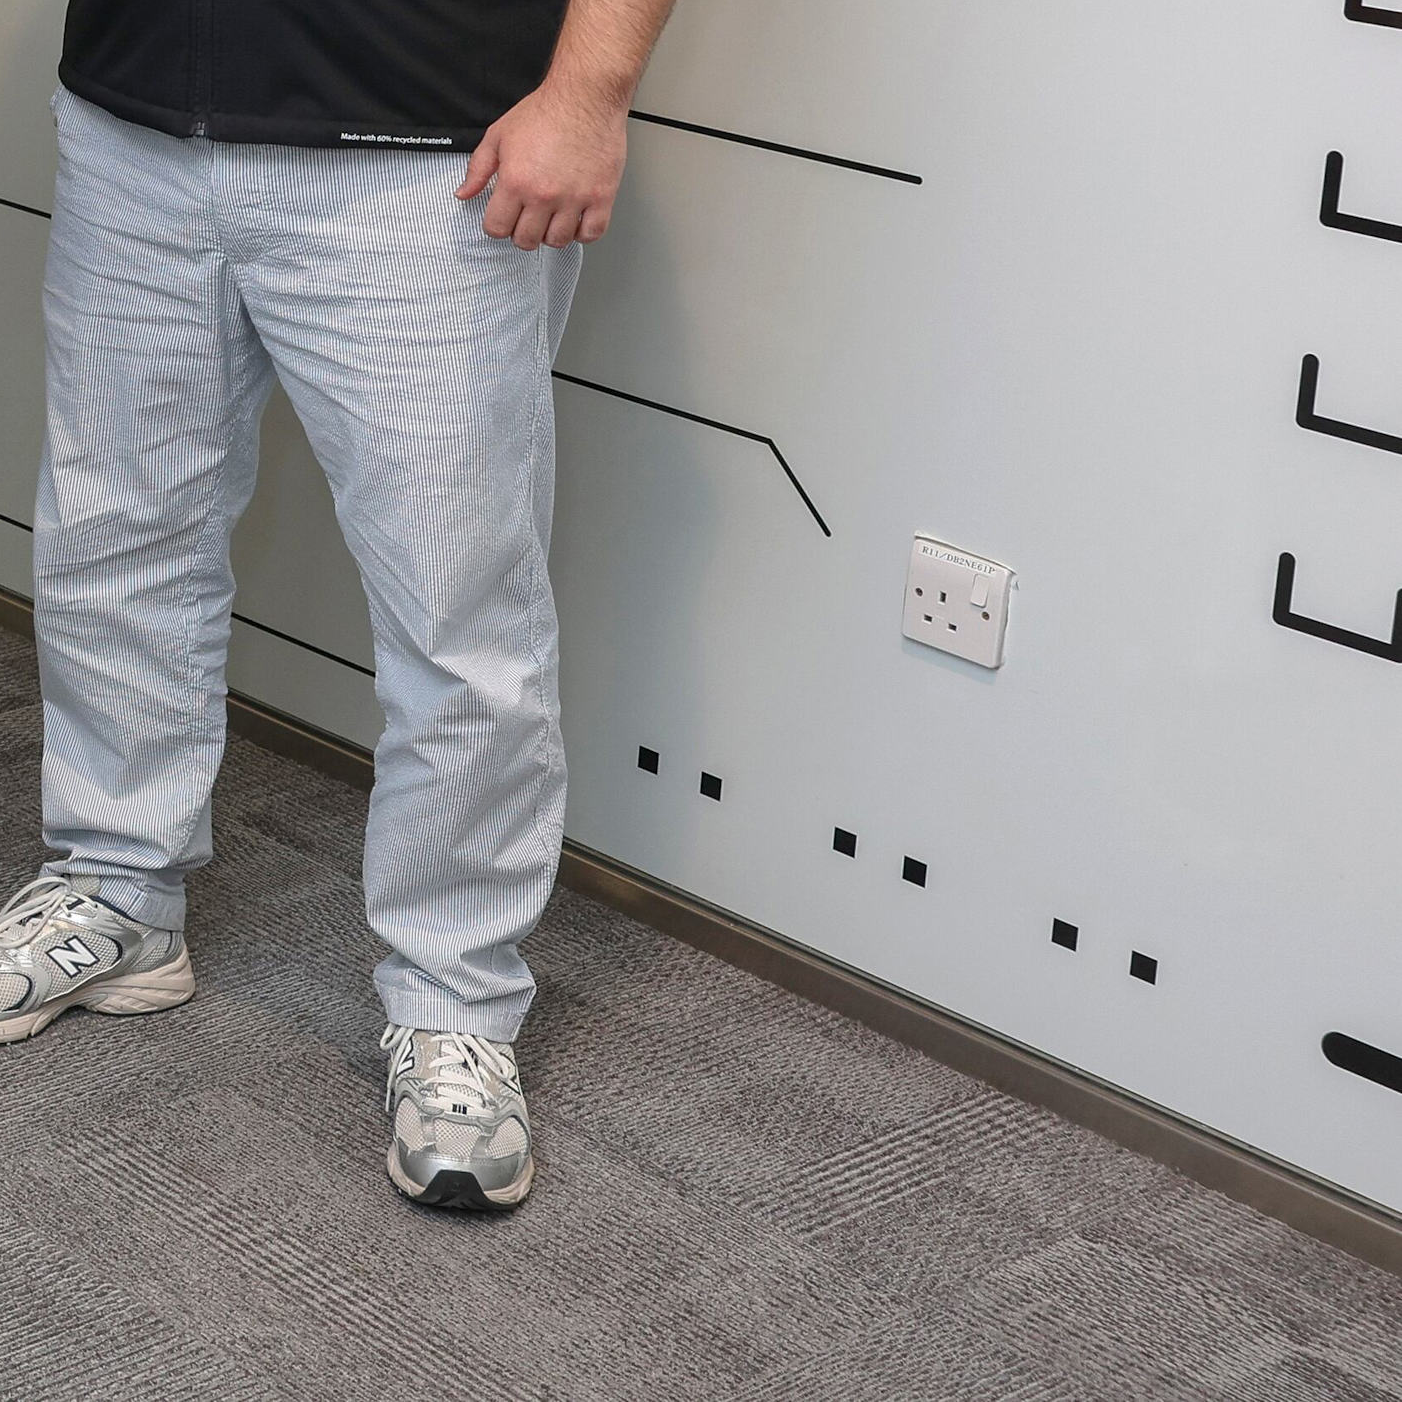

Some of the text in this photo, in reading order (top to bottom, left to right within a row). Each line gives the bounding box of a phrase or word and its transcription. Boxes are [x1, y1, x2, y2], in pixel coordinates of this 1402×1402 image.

[340, 133, 360, 141] Made
[392, 136, 421, 144] recycled
[422, 137, 452, 145] materials
